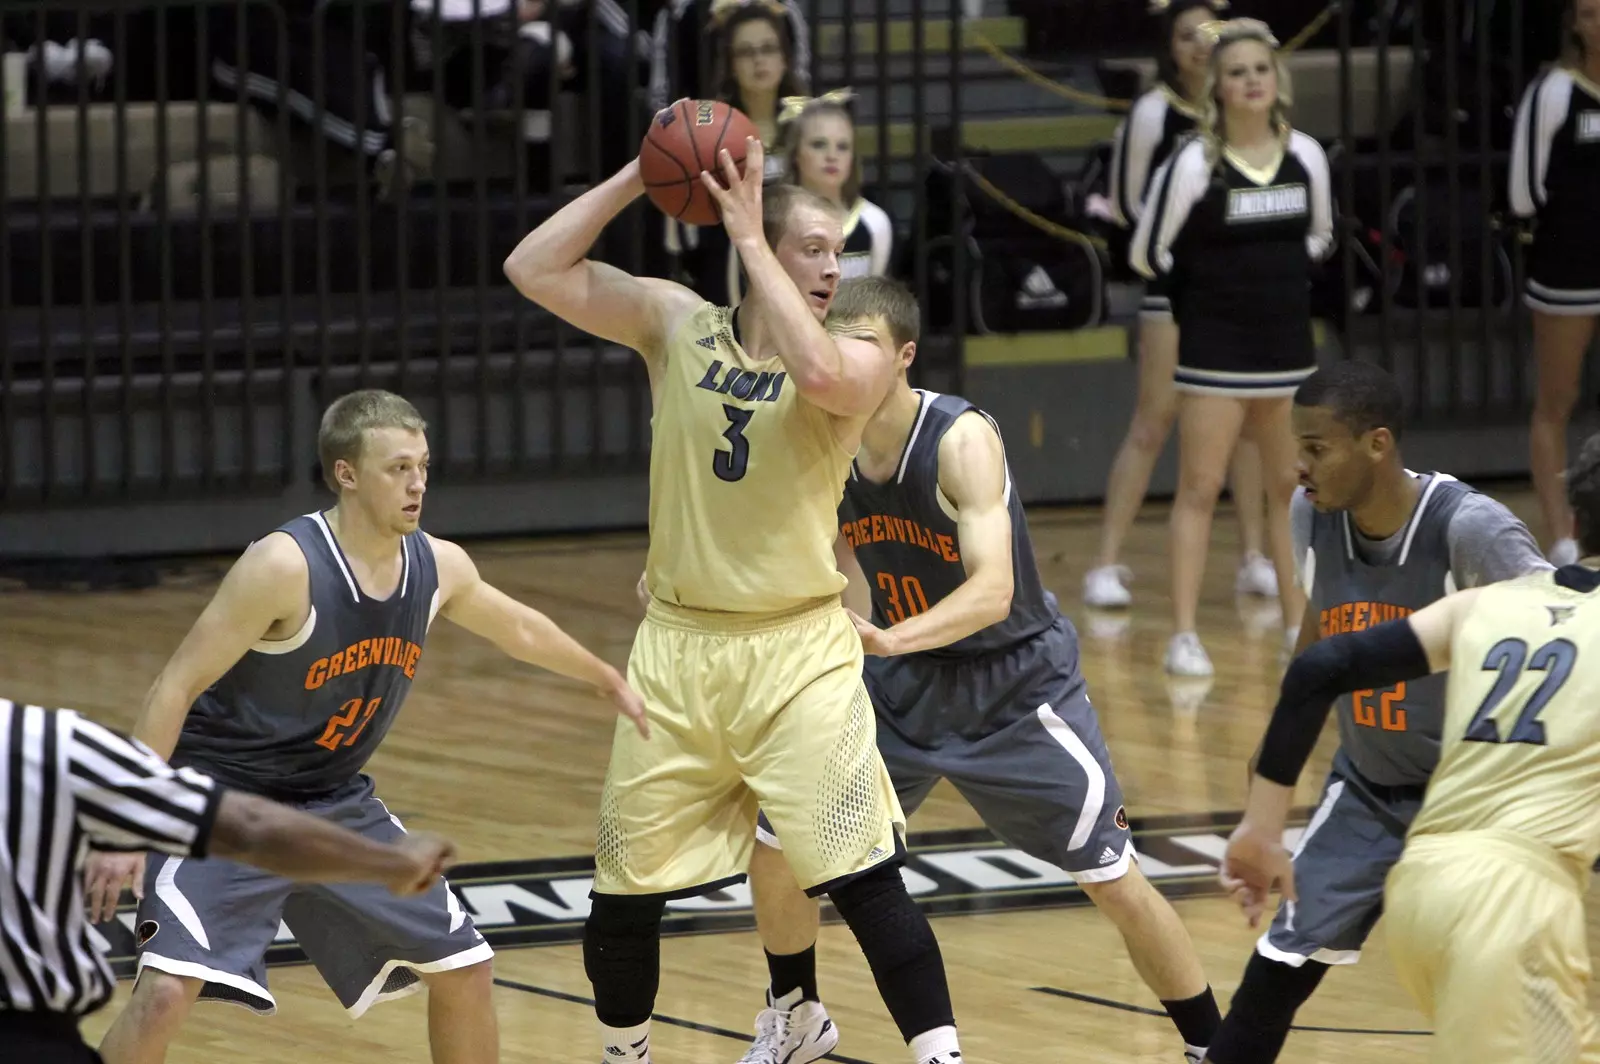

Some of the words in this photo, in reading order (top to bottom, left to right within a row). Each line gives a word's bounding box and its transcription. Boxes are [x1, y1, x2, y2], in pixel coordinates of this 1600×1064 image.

[696, 359, 787, 402] LIONS
[712, 403, 755, 482] 3
[841, 514, 960, 562] GREENVILLE
[876, 571, 929, 625] 30
[1462, 637, 1578, 745] 22
